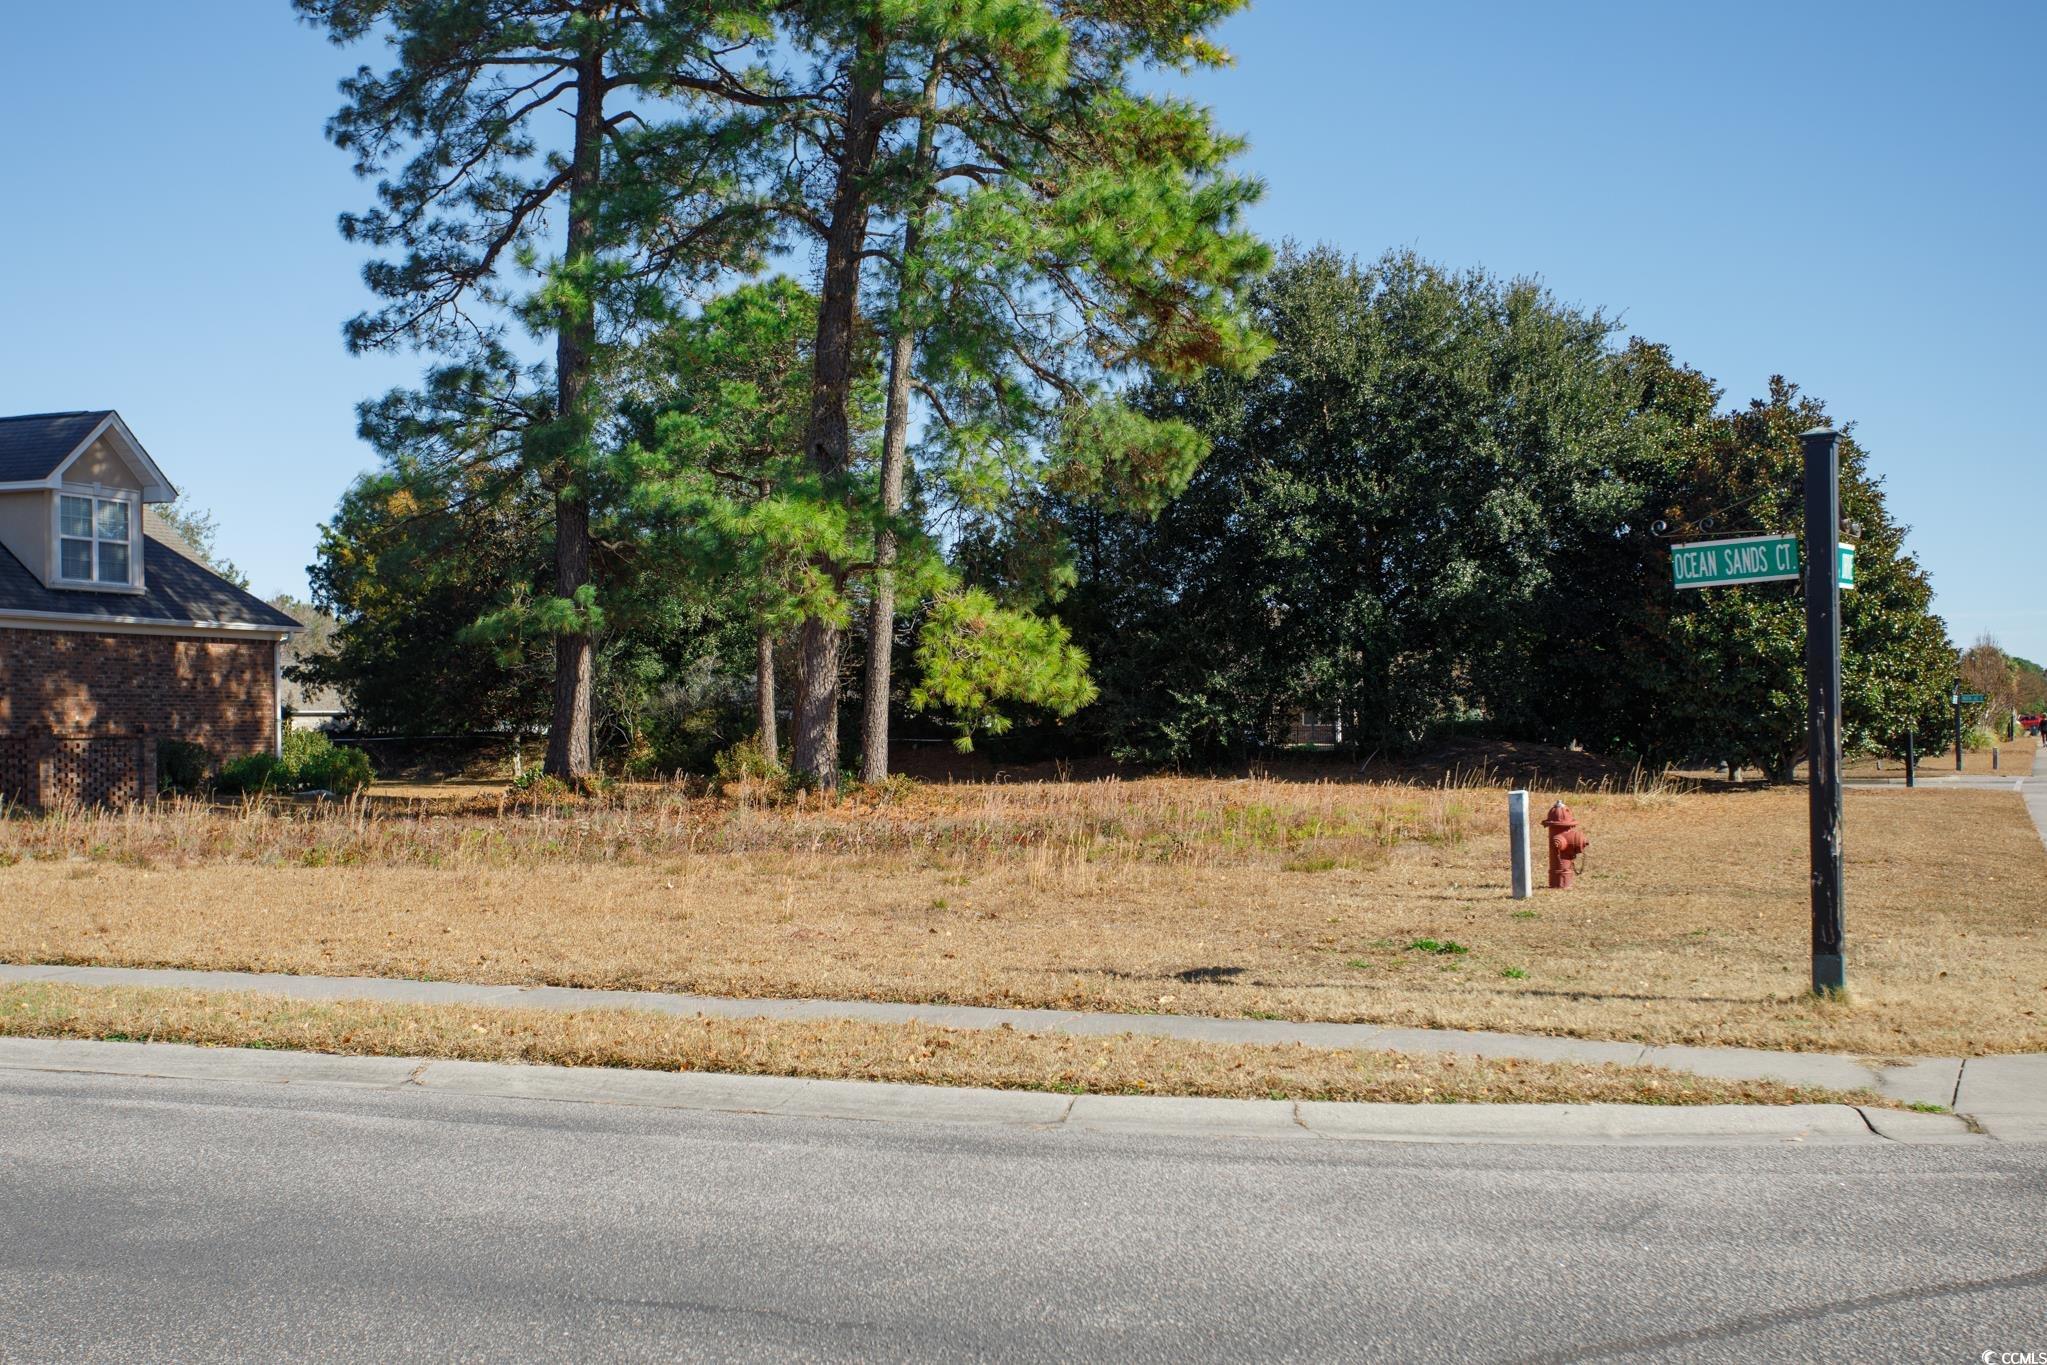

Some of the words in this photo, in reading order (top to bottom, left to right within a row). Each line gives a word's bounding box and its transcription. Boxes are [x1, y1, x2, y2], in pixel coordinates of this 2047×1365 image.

[1674, 550, 1718, 580] OCEAN
[1724, 544, 1769, 575] SANDS
[1775, 543, 1797, 571] CT.
